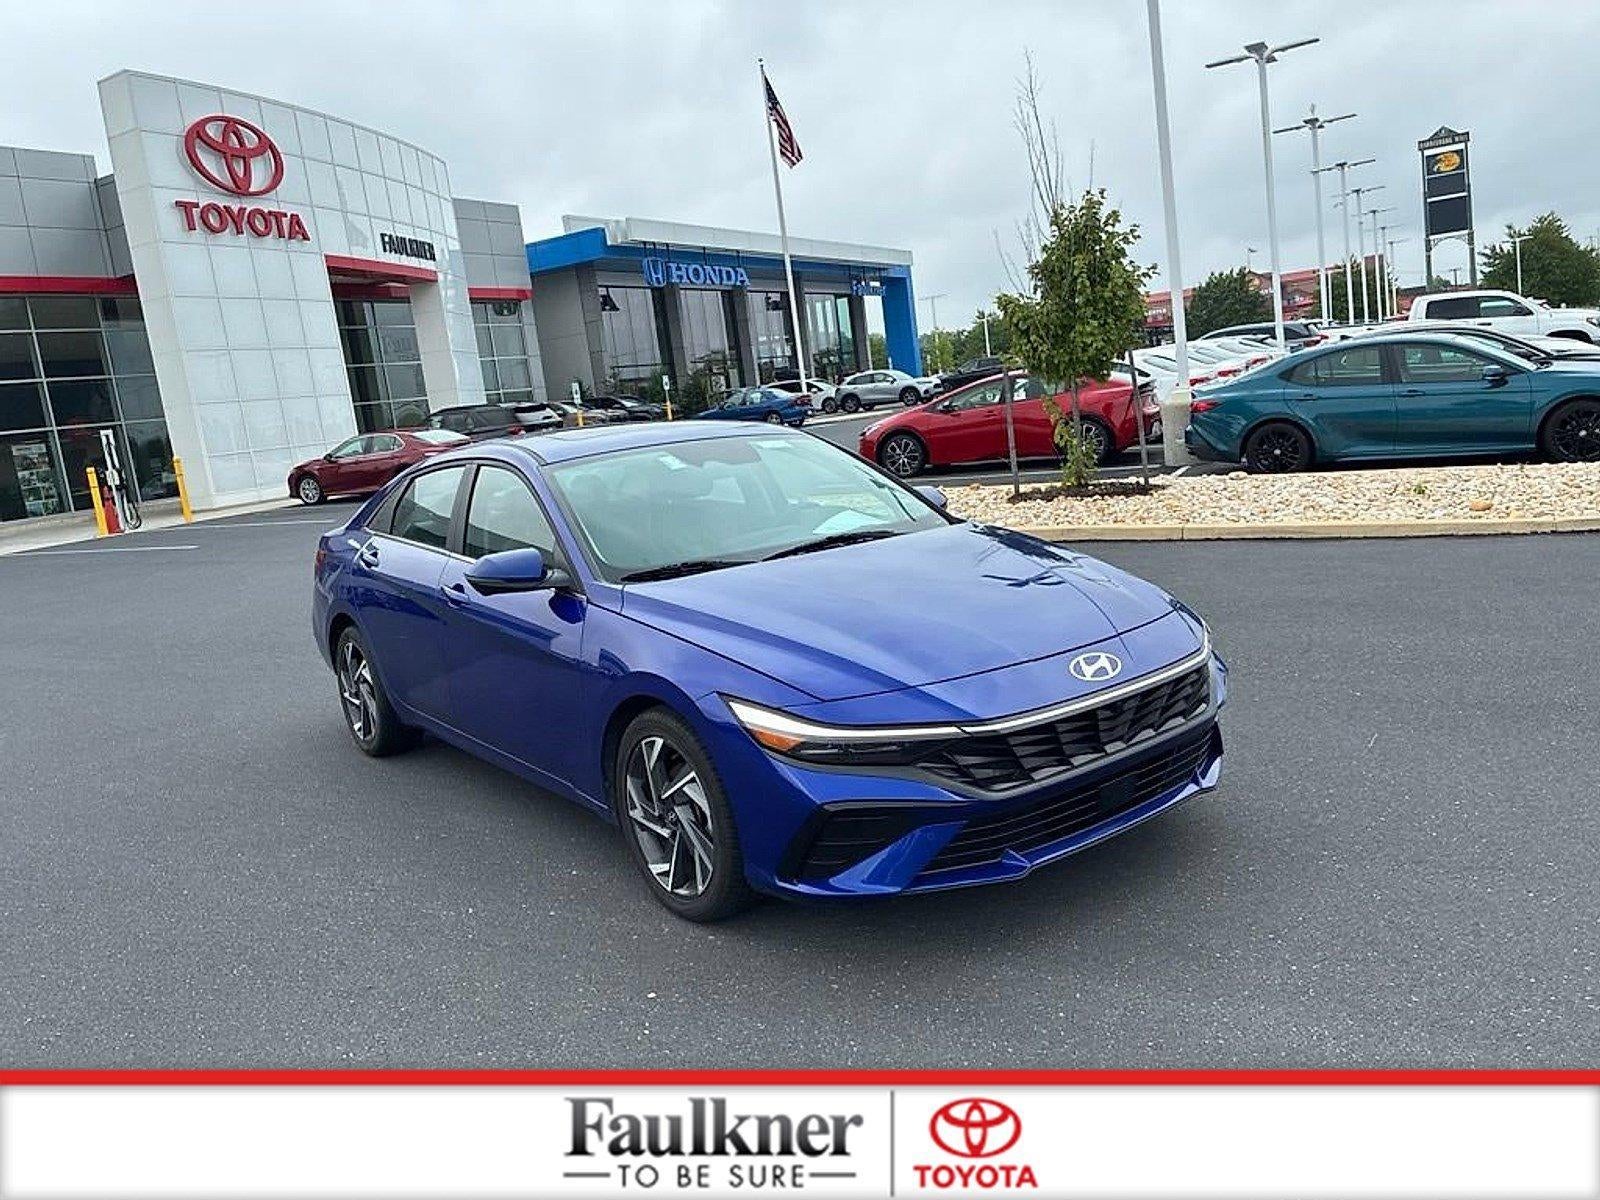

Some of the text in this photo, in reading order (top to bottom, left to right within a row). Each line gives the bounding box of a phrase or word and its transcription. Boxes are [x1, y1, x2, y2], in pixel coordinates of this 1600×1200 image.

[175, 200, 310, 241] TOYOTA
[380, 233, 437, 262] FAULKNER
[666, 262, 751, 286] HONDA
